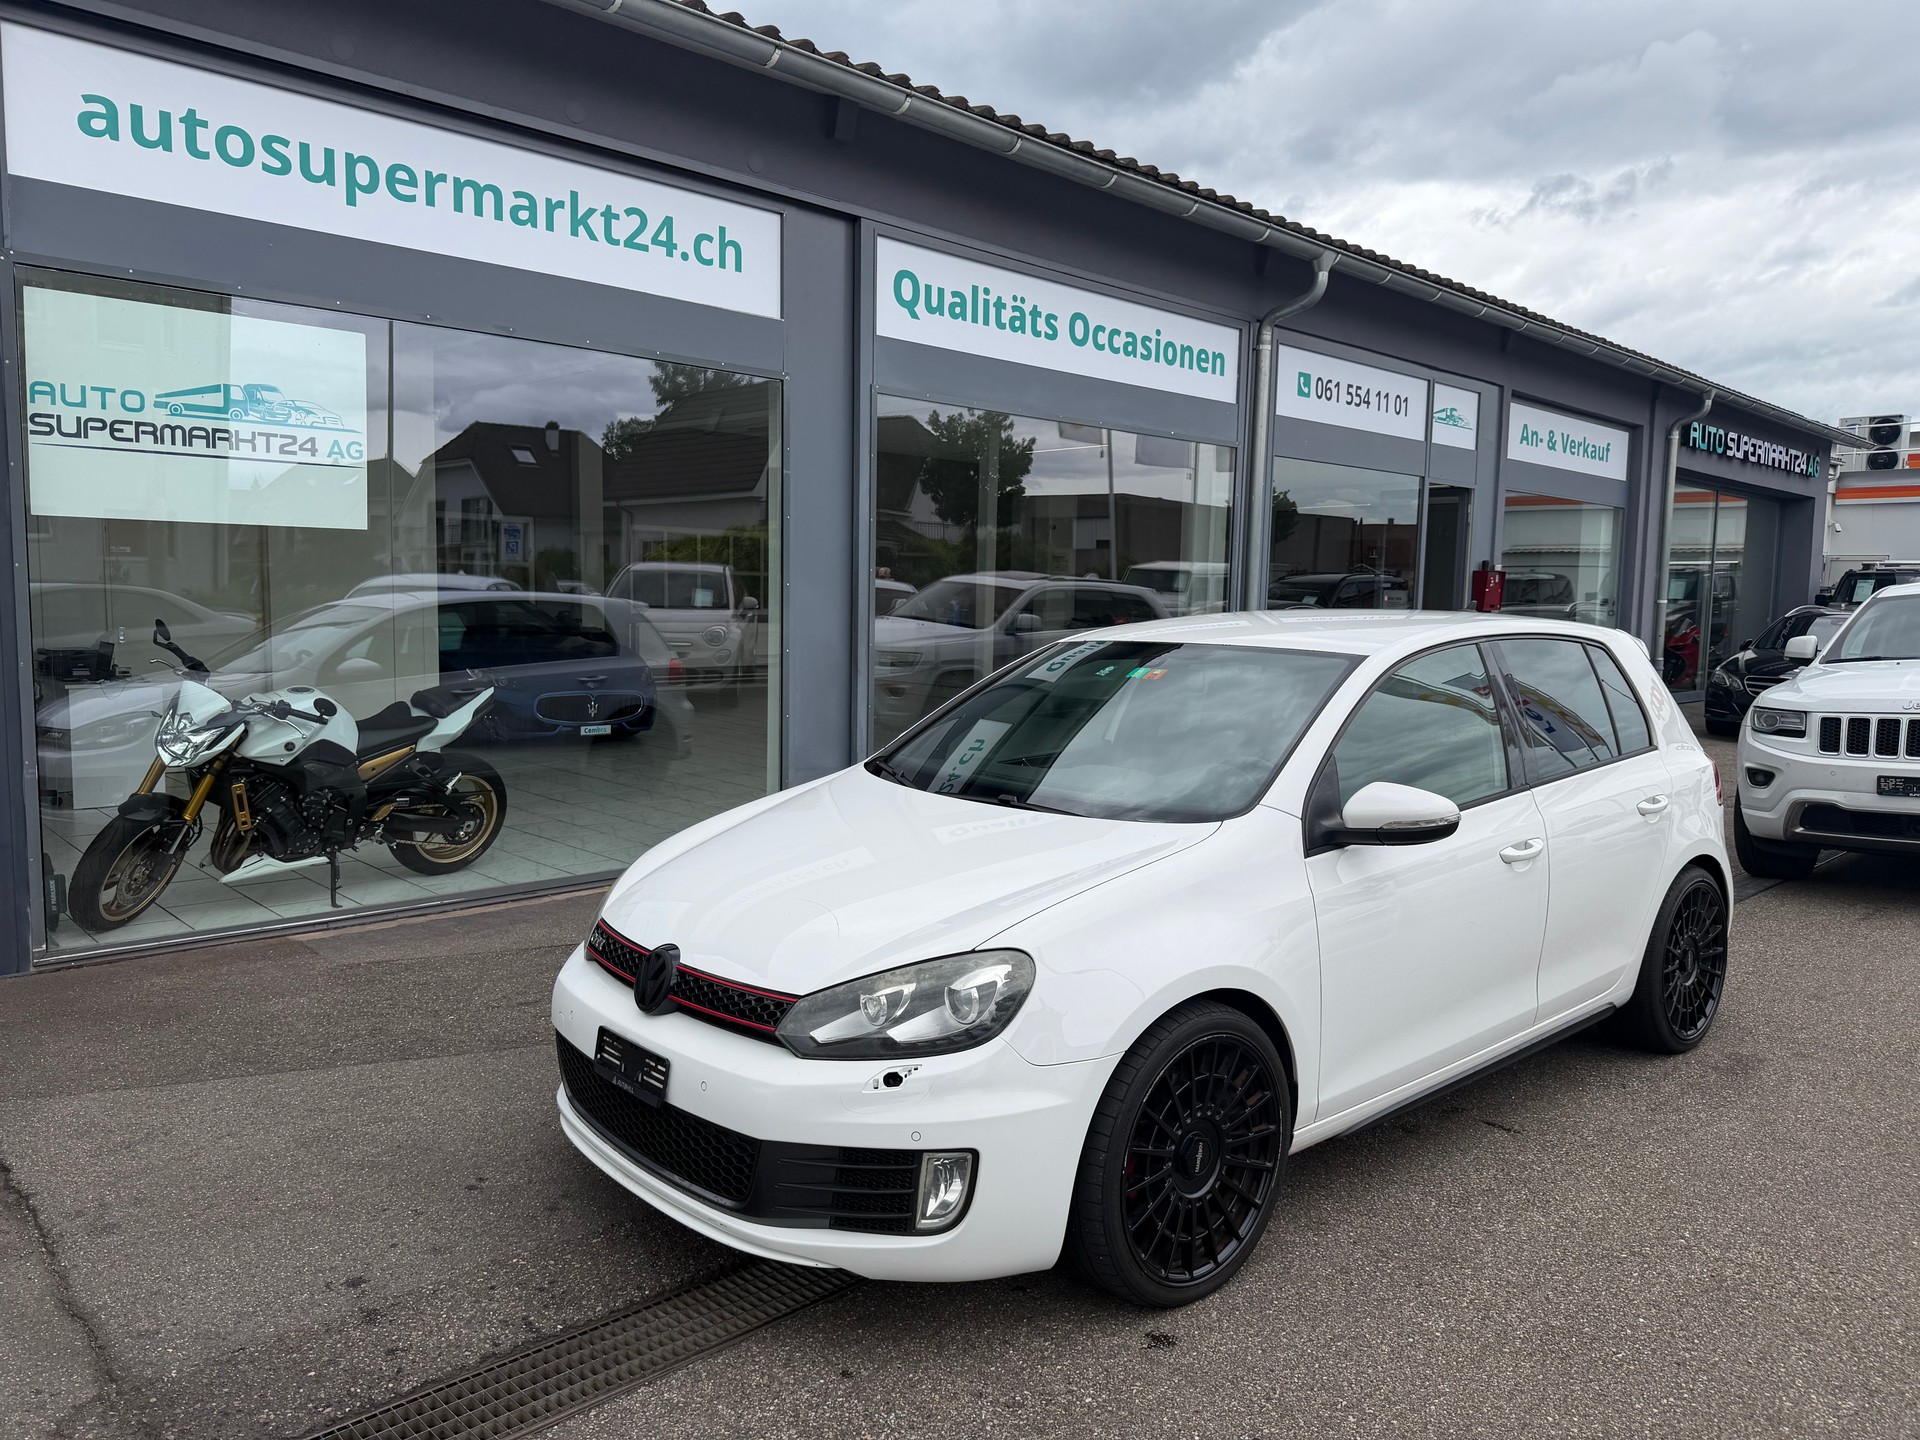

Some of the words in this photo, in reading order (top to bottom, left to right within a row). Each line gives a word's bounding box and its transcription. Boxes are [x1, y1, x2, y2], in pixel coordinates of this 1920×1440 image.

[77, 93, 744, 273] autosupermarkt24.ch
[893, 269, 1059, 342] Qualitäts
[1068, 312, 1226, 378] Occasionen
[29, 381, 146, 414] AUTO
[1315, 377, 1341, 403] 061
[1345, 383, 1371, 410] 554
[1375, 390, 1390, 414] 11
[1394, 394, 1409, 417] 01
[29, 412, 319, 458] SUPERMARKT24
[326, 439, 364, 461] AG
[1520, 423, 1544, 448] An-
[1546, 429, 1558, 452] &
[1560, 432, 1611, 463] Verkauf
[1690, 421, 1726, 454] AUTO
[1726, 431, 1808, 475] SUPERMARKT24
[1807, 455, 1821, 478] AG
